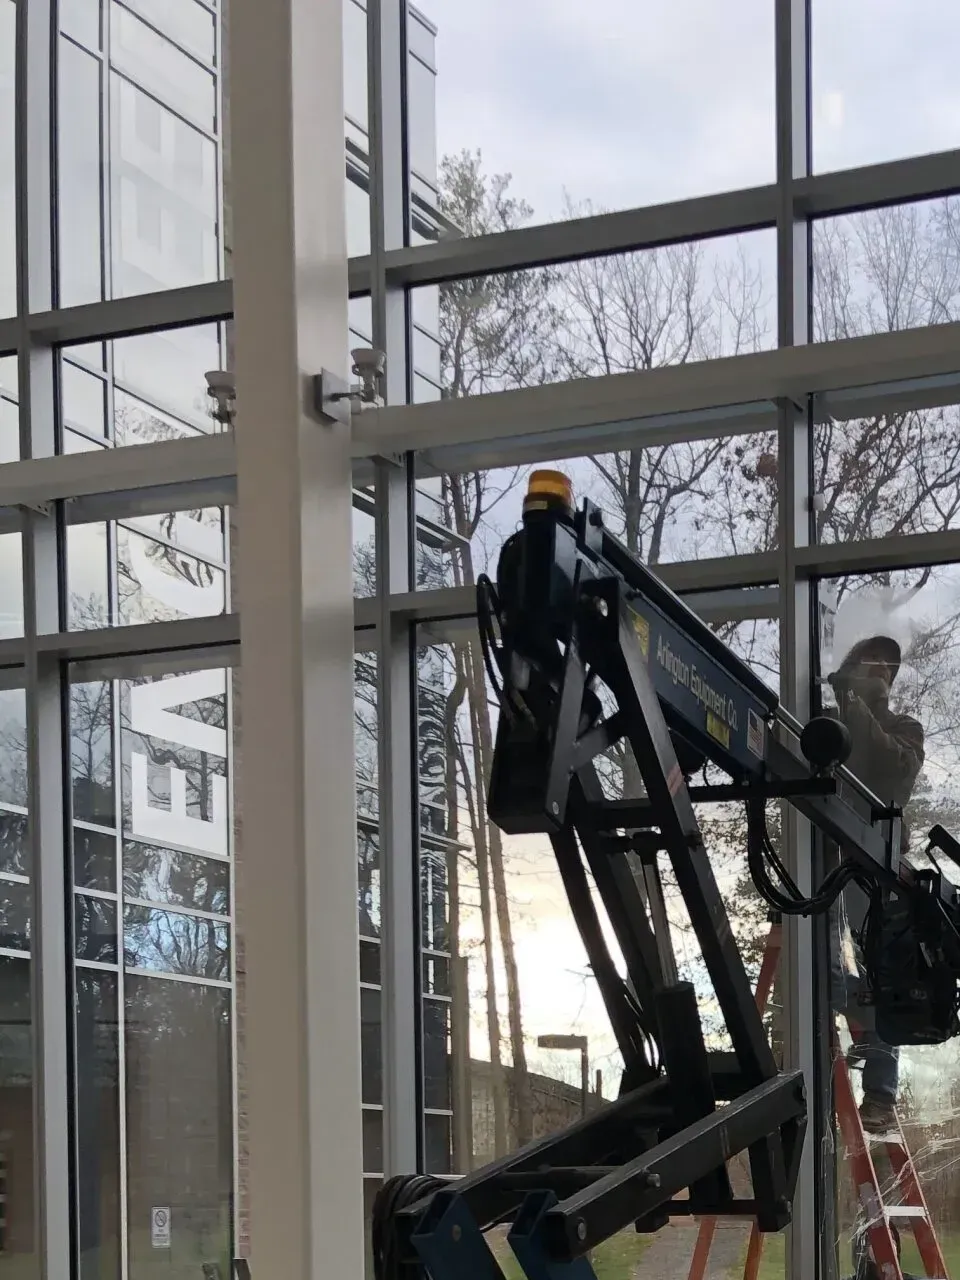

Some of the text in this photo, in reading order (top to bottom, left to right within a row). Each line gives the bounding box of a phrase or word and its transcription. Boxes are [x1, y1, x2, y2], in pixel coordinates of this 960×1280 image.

[657, 634, 690, 688] Arlington
[690, 663, 727, 721] Equipment
[728, 698, 738, 731] Co.
